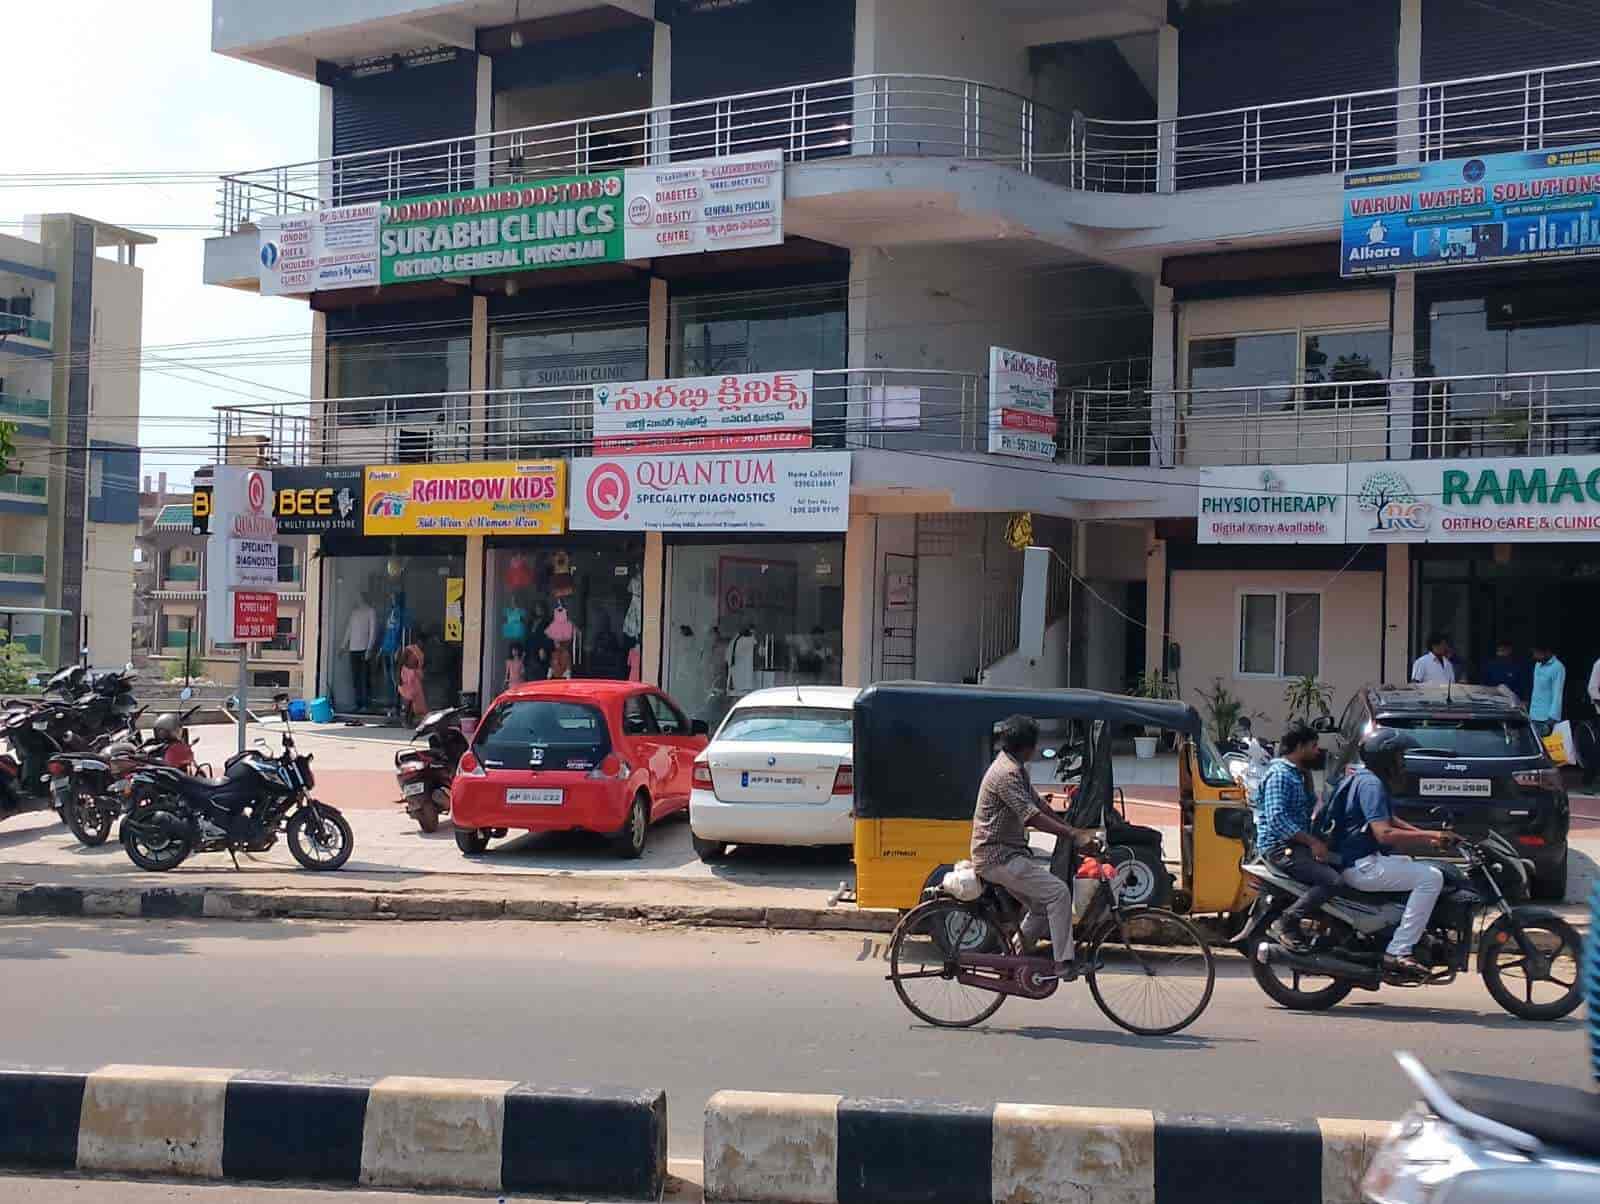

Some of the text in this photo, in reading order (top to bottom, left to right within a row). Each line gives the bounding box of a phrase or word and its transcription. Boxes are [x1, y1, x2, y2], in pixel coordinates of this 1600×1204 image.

[388, 180, 604, 221] LONDON TRAINED DOCTORS
[656, 187, 697, 203] DIABETES
[1350, 197, 1411, 217] VARUN
[1419, 187, 1485, 209] WATER
[704, 199, 770, 217] GENERAL PHYSICIAN
[656, 210, 691, 224] OBESITY
[280, 231, 308, 243] LONDON
[382, 217, 499, 257] SURABHI
[500, 203, 615, 243] CLINICS
[656, 230, 689, 243] CENTRE
[393, 257, 442, 277] ORTHO
[454, 249, 521, 270] GENERAL
[523, 239, 606, 264] PHYSICIAN
[537, 366, 587, 384] SURABHI
[636, 459, 776, 491] QUANTUM
[412, 476, 555, 503] RAINBOW KIDS
[636, 492, 776, 504] SPECIALITY DIAGNOSTICS
[1201, 495, 1337, 513] PHYSIOTHERAPY
[1212, 522, 1245, 536] Digital
[1277, 521, 1326, 534] Available
[1441, 517, 1494, 530] ORTHO
[1496, 516, 1535, 528] CARE
[1539, 516, 1550, 528] &
[241, 541, 273, 553] SPECIALITY
[235, 555, 277, 569] DIAGNOSTICS
[1443, 762, 1468, 772] Jeep
